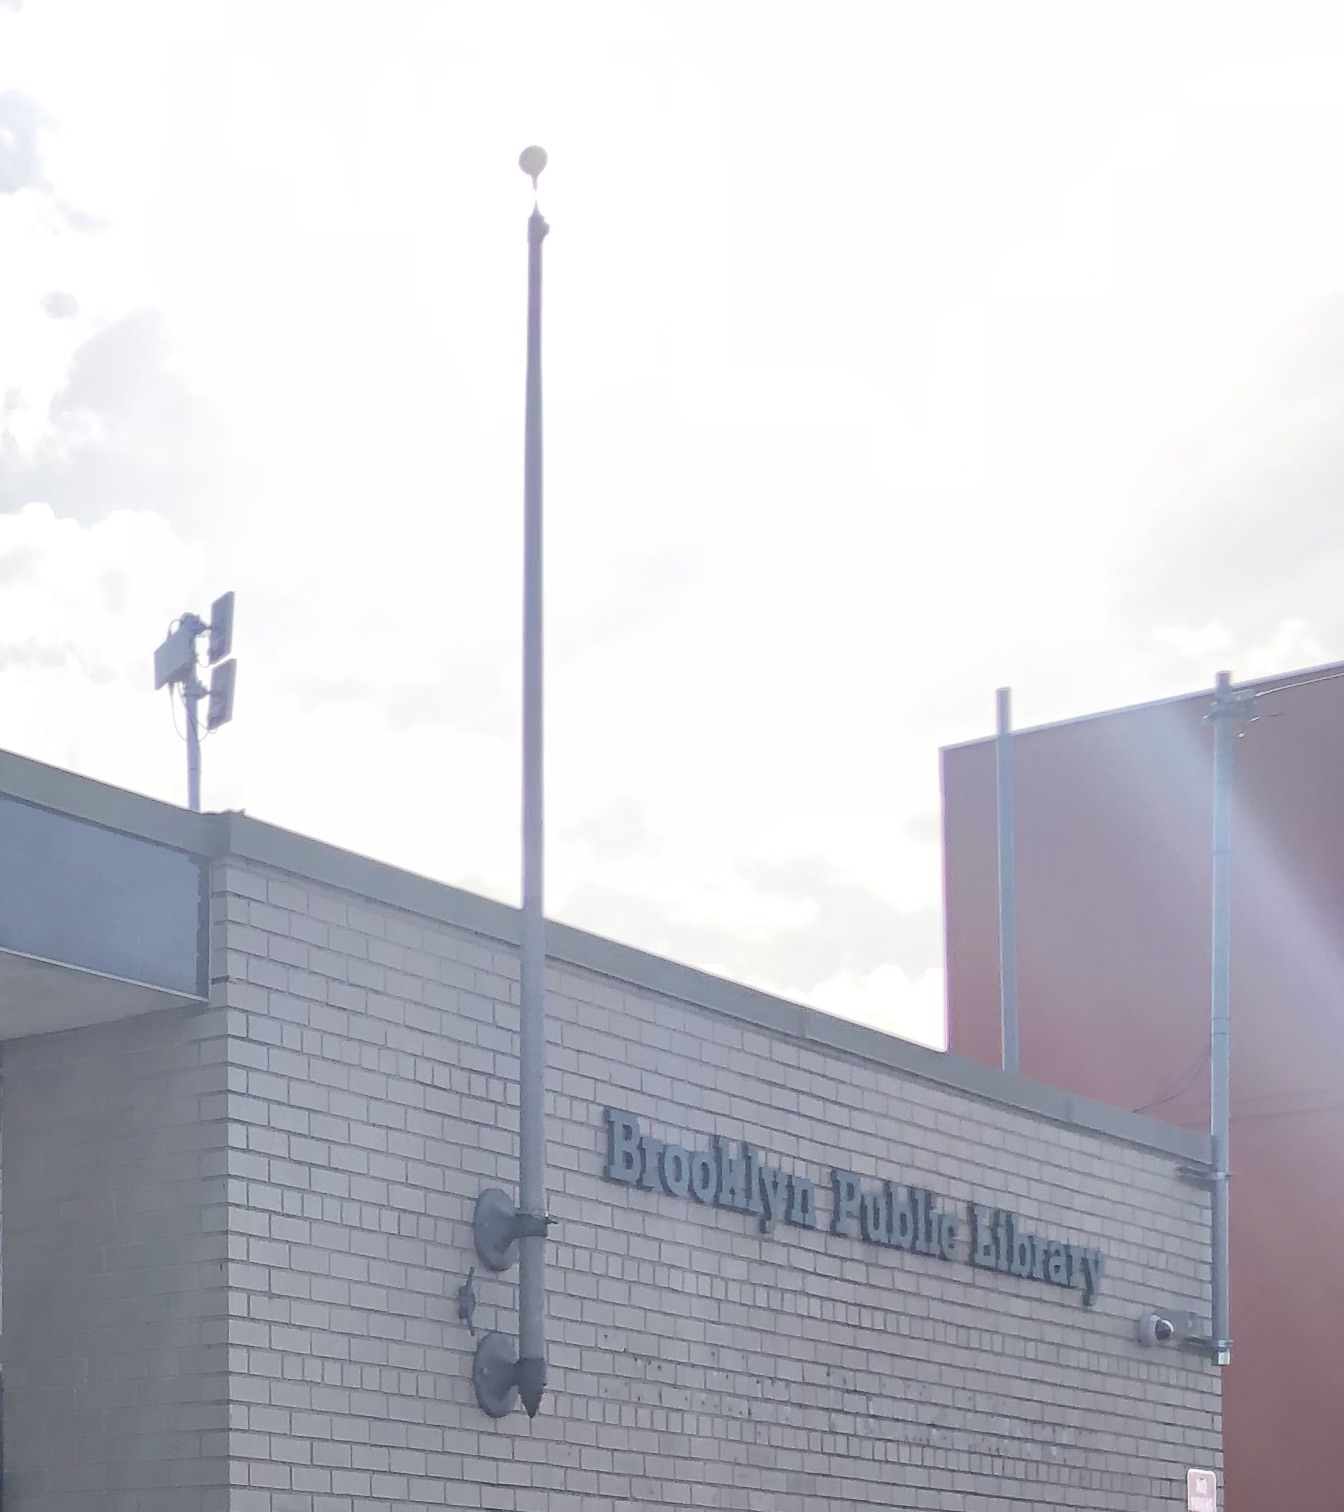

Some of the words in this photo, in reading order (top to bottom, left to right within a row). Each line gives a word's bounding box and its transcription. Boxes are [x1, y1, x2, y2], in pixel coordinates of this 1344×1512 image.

[603, 1106, 816, 1233] Brooklyn
[831, 1169, 959, 1261] Public
[969, 1202, 1107, 1307] Library
